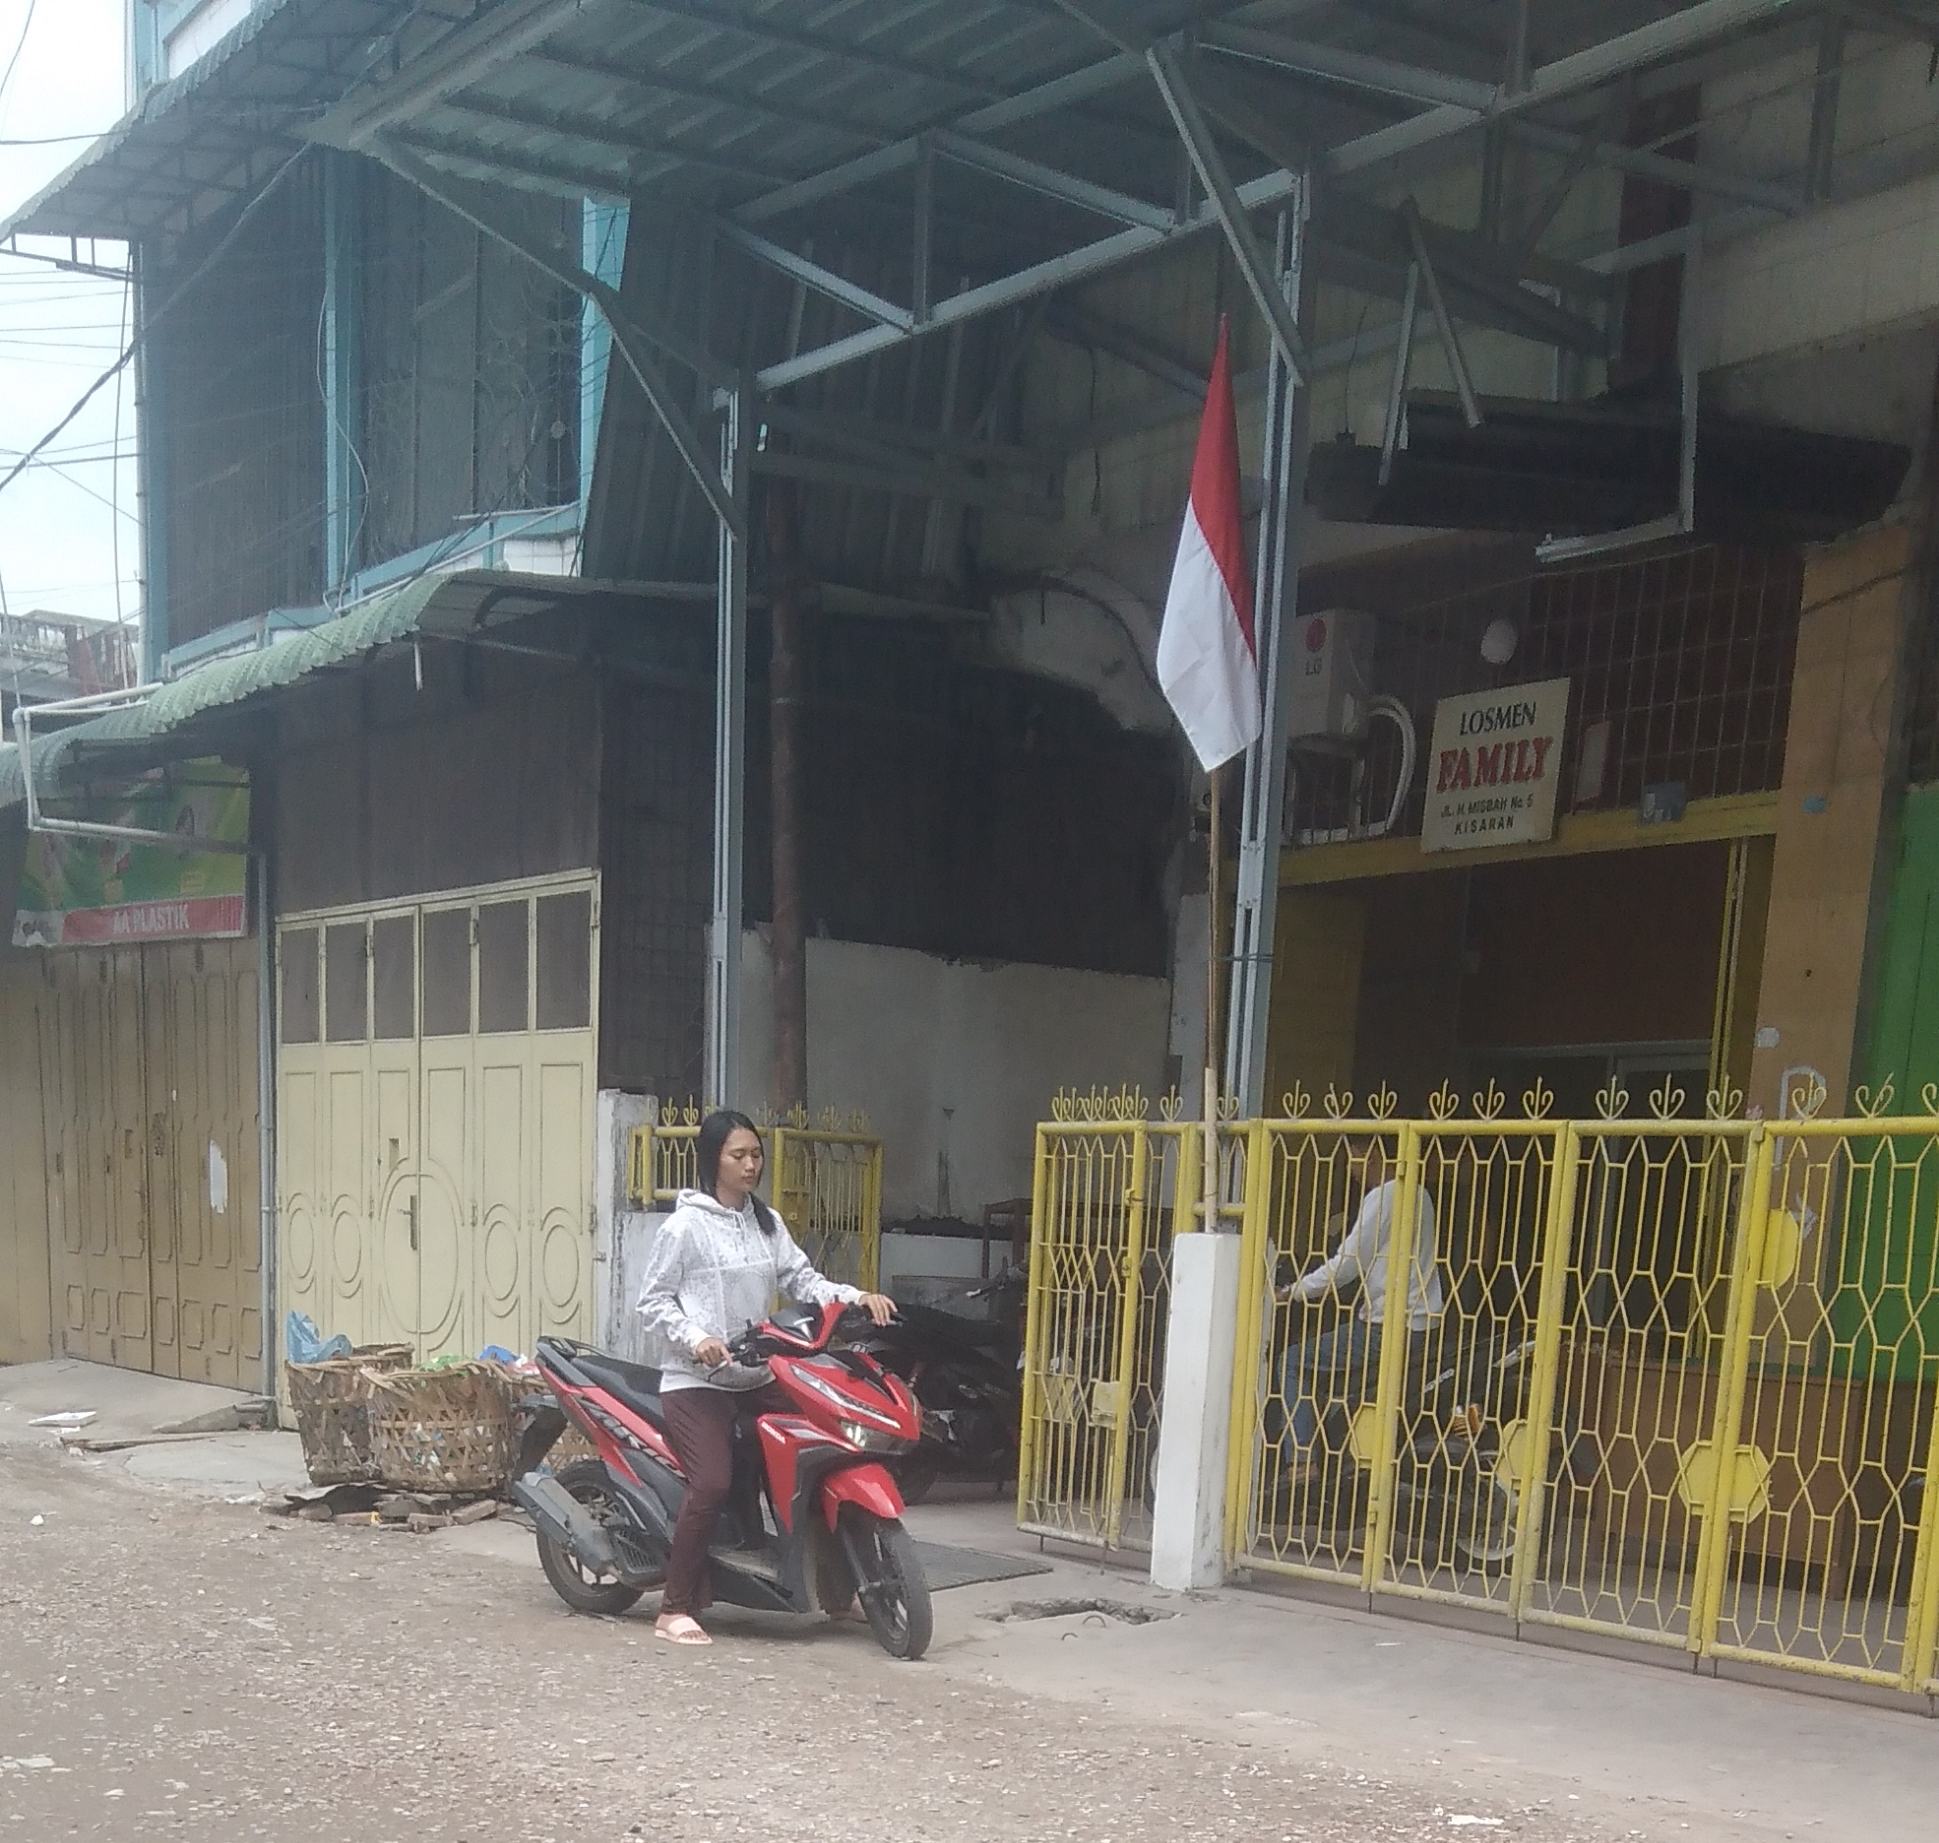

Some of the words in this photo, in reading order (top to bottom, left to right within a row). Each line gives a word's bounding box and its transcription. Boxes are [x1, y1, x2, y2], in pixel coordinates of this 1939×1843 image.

[1459, 702, 1537, 736] LOSMEN
[1436, 736, 1554, 794] FAMILY
[1454, 815, 1514, 835] KISARAN
[133, 903, 190, 932] PLASTIK
